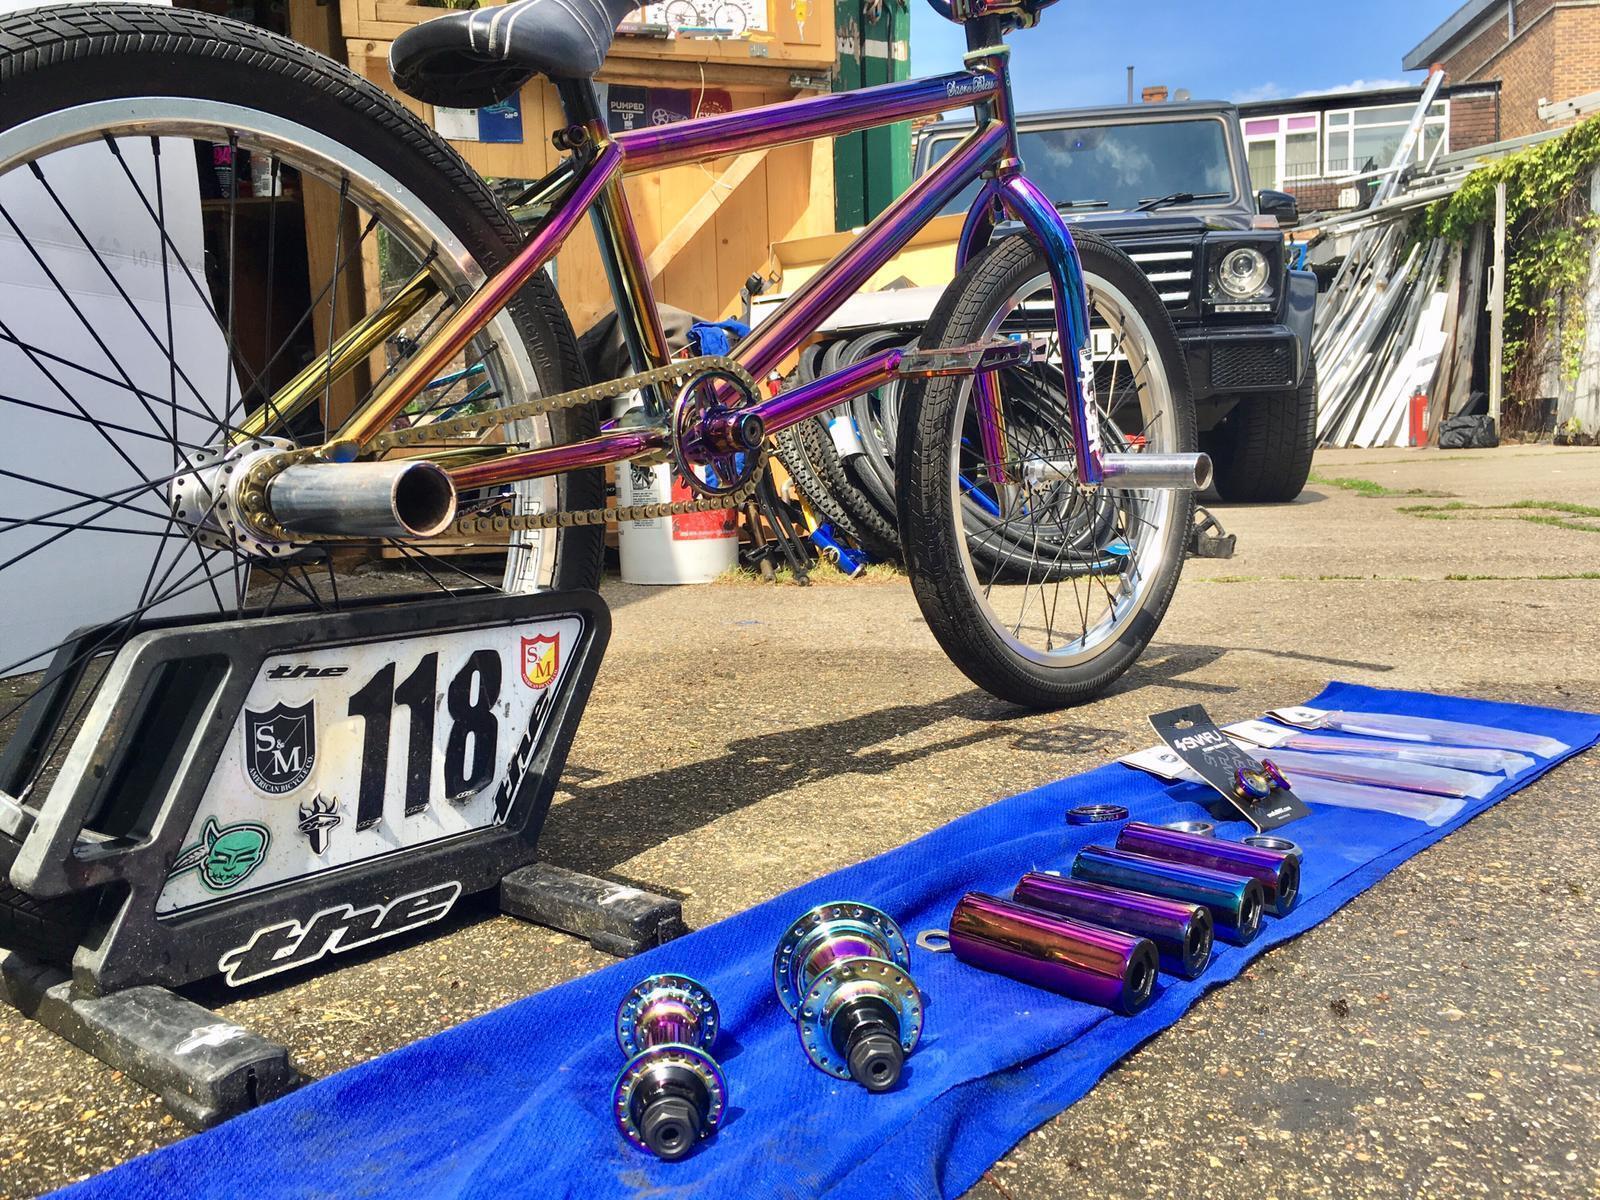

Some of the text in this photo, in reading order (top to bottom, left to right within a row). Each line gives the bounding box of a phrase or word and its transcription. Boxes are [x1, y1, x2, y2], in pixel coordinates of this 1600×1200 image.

[610, 101, 645, 110] PUMPED
[622, 113, 634, 121] UP
[266, 664, 350, 680] the
[348, 649, 502, 833] 118
[249, 755, 314, 792] AMERICAN BICYCLE CO.
[218, 881, 463, 988] the
